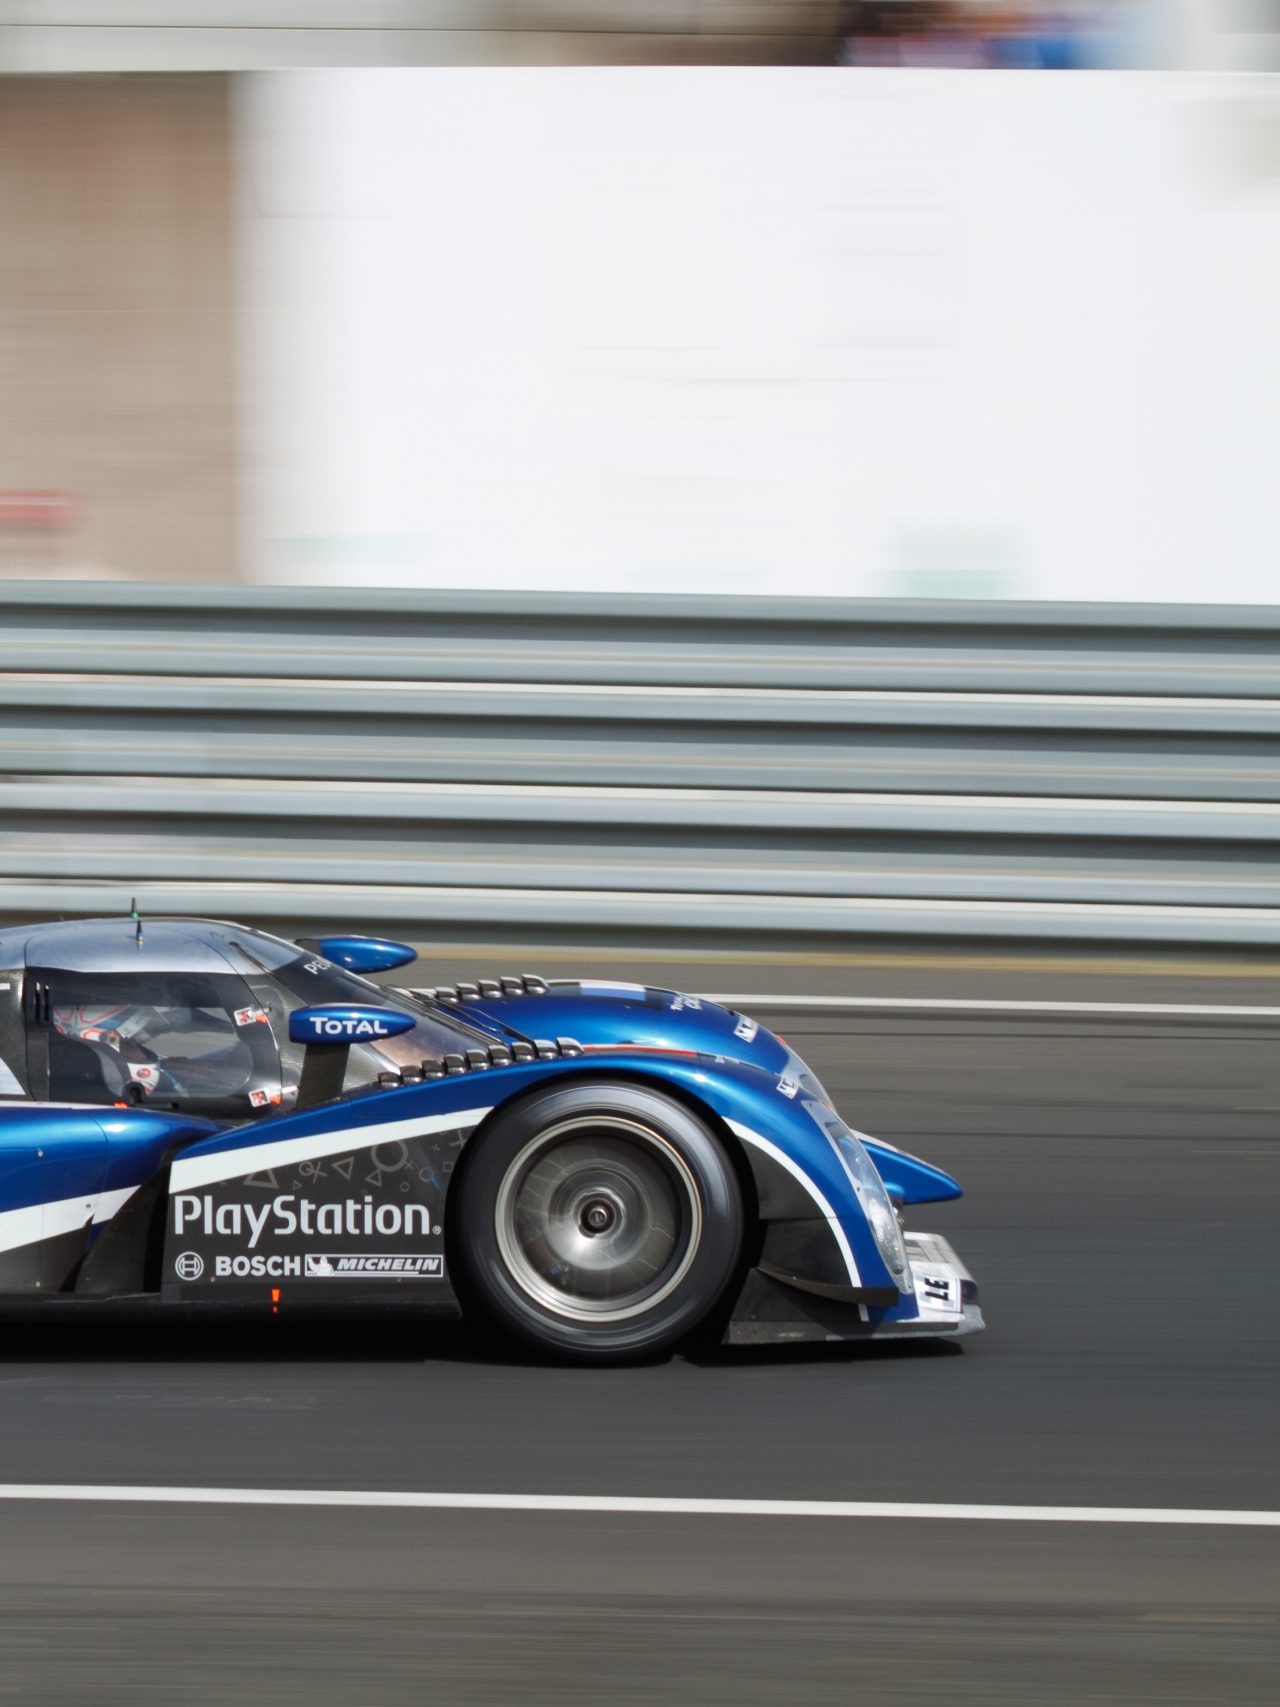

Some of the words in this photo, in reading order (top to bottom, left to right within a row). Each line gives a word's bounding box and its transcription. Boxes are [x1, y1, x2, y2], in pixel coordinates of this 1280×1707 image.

[309, 1017, 388, 1035] TOTAL
[174, 1194, 431, 1248] PlayStation
[215, 1255, 301, 1277] BOSCH
[336, 1258, 439, 1271] MICHELIN
